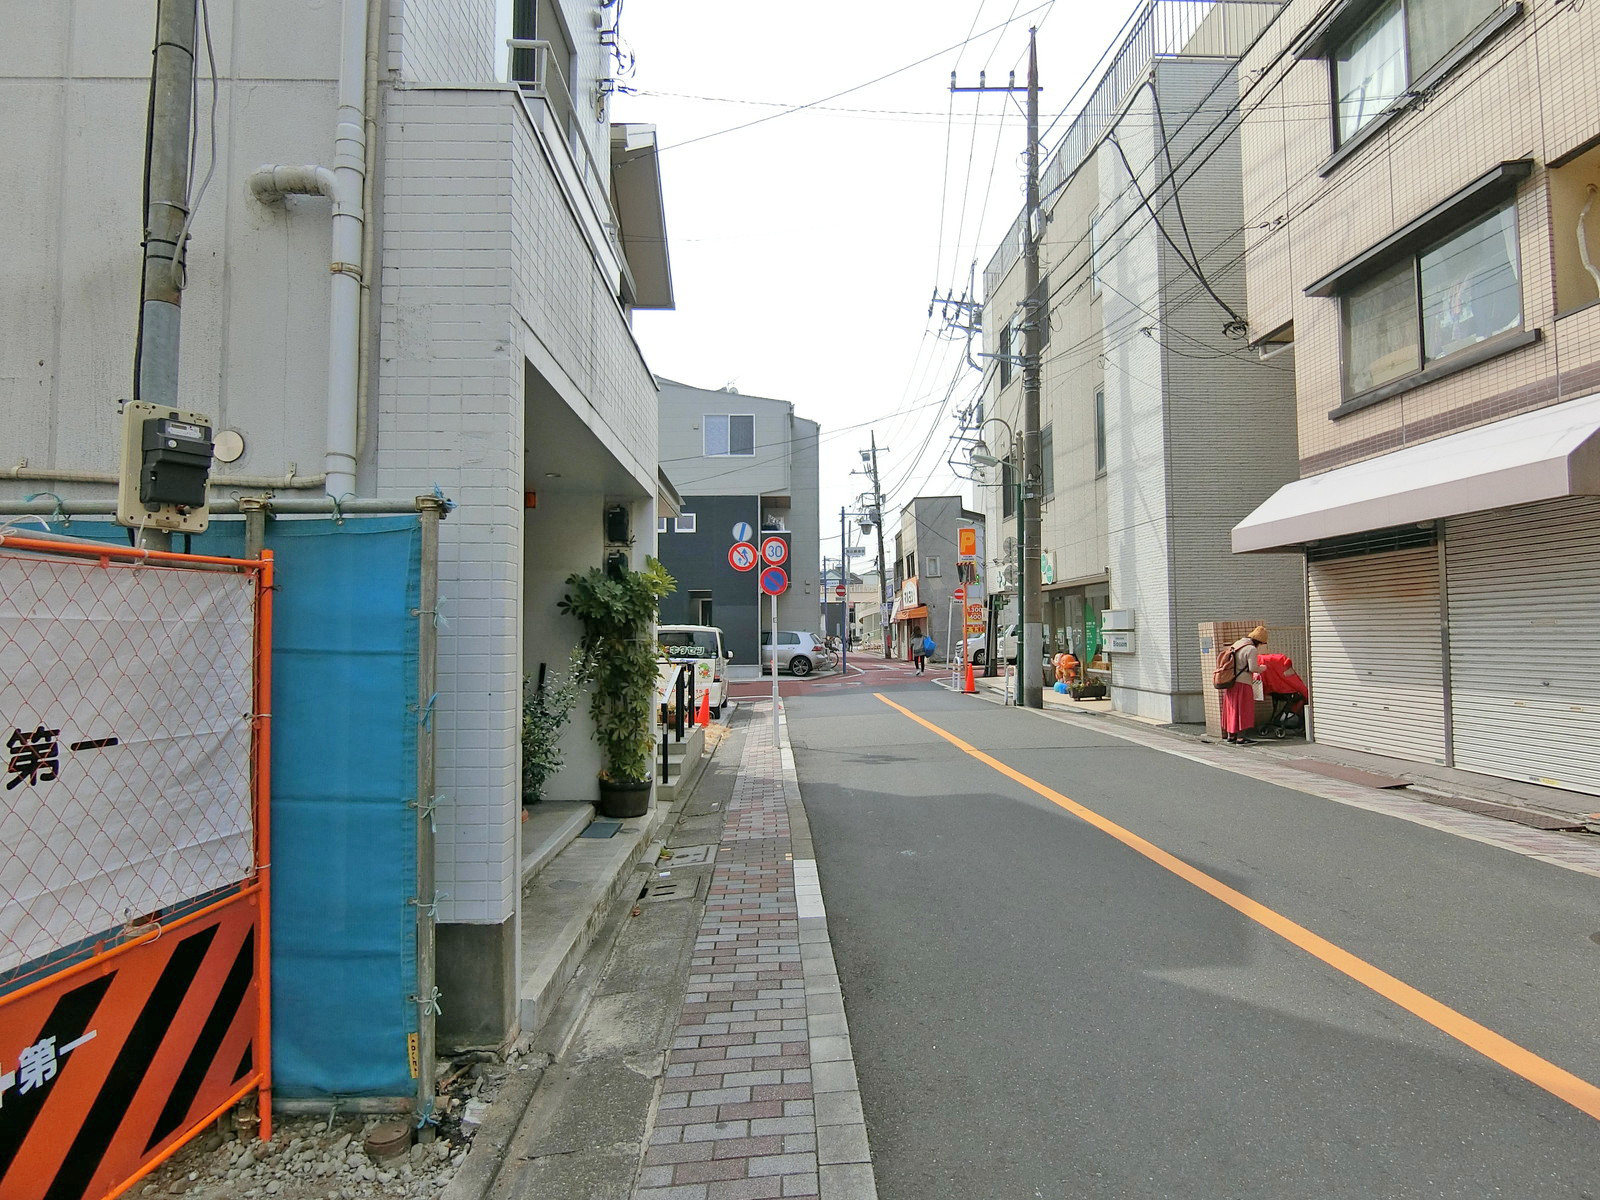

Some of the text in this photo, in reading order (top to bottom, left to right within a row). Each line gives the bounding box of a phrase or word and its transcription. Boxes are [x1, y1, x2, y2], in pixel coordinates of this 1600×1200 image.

[768, 545, 783, 558] 30
[6, 725, 119, 791] 第一
[18, 1029, 97, 1096] 第一
